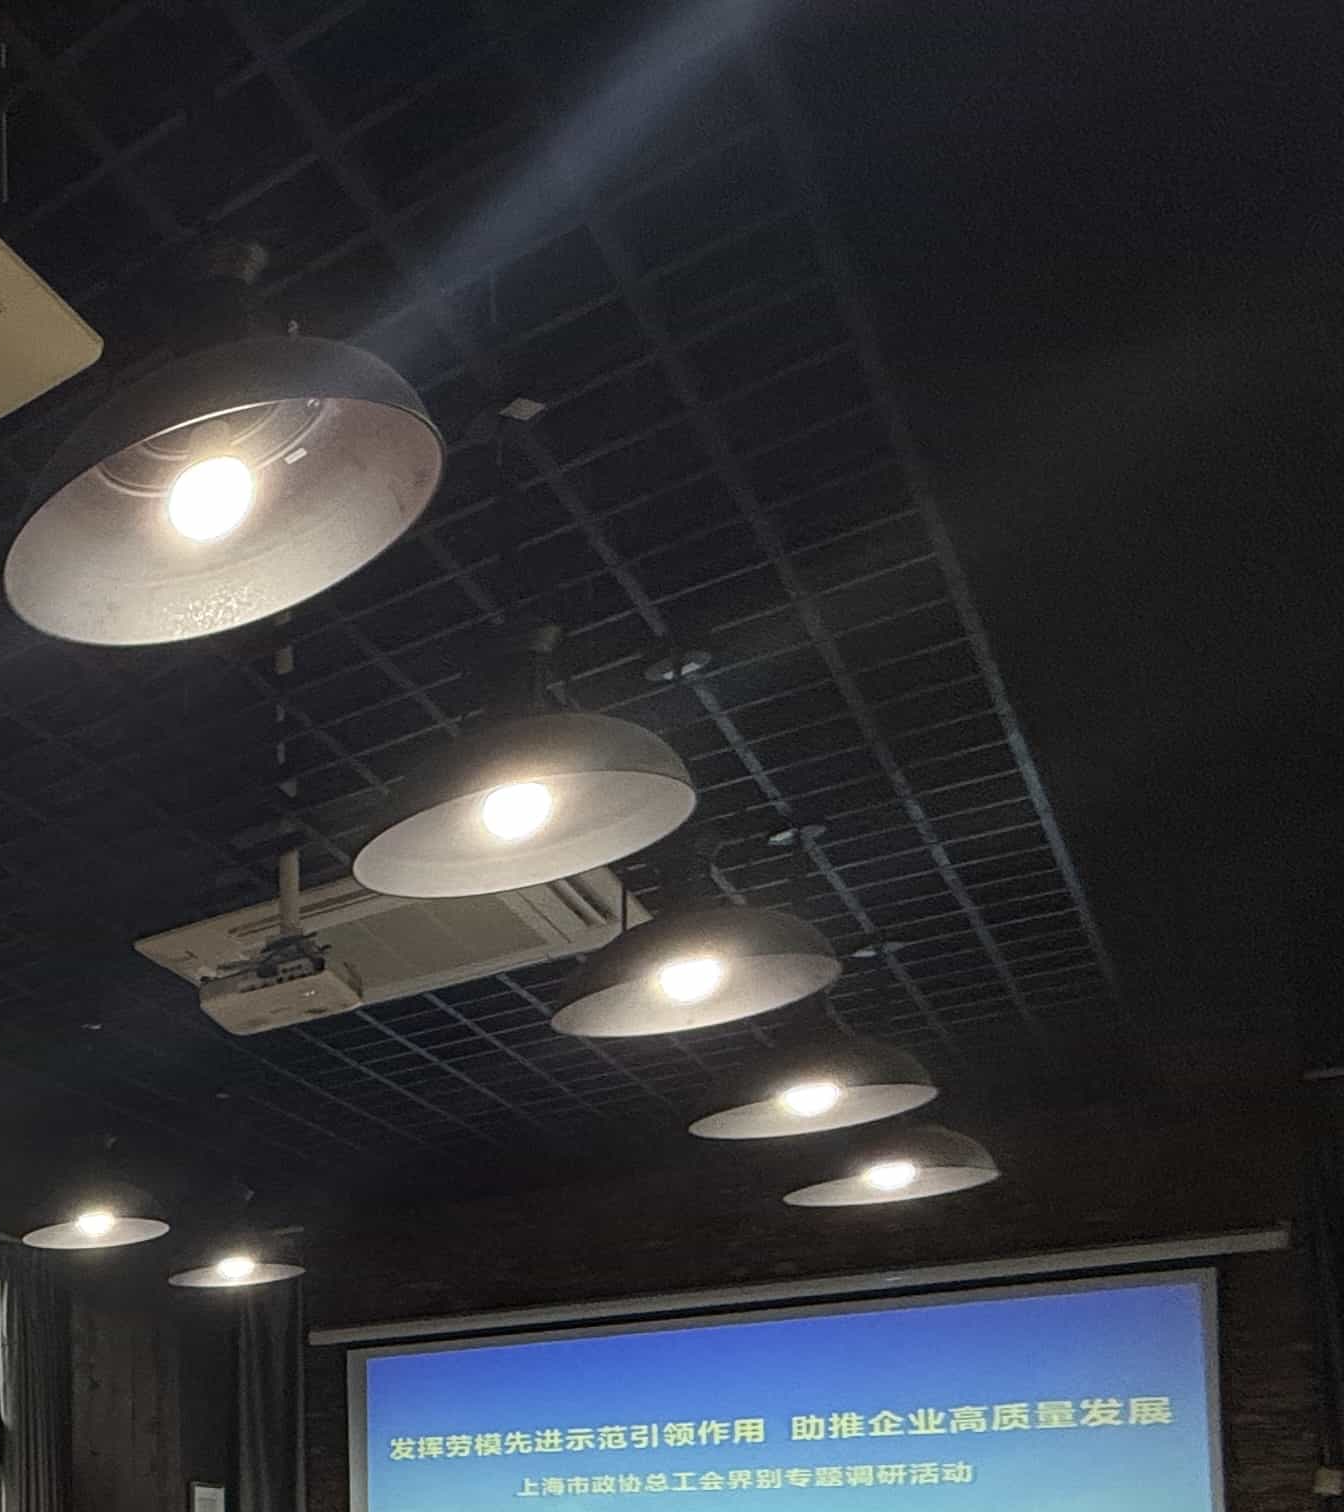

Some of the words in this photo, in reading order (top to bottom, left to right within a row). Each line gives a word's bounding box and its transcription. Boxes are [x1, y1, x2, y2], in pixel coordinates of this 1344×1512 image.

[389, 1417, 765, 1461] 发挥劳模先进示范引领作用
[790, 1396, 1173, 1441] 助推企业高质量发展
[516, 1461, 974, 1498] 上海市政协总工会界别专题调研活动
